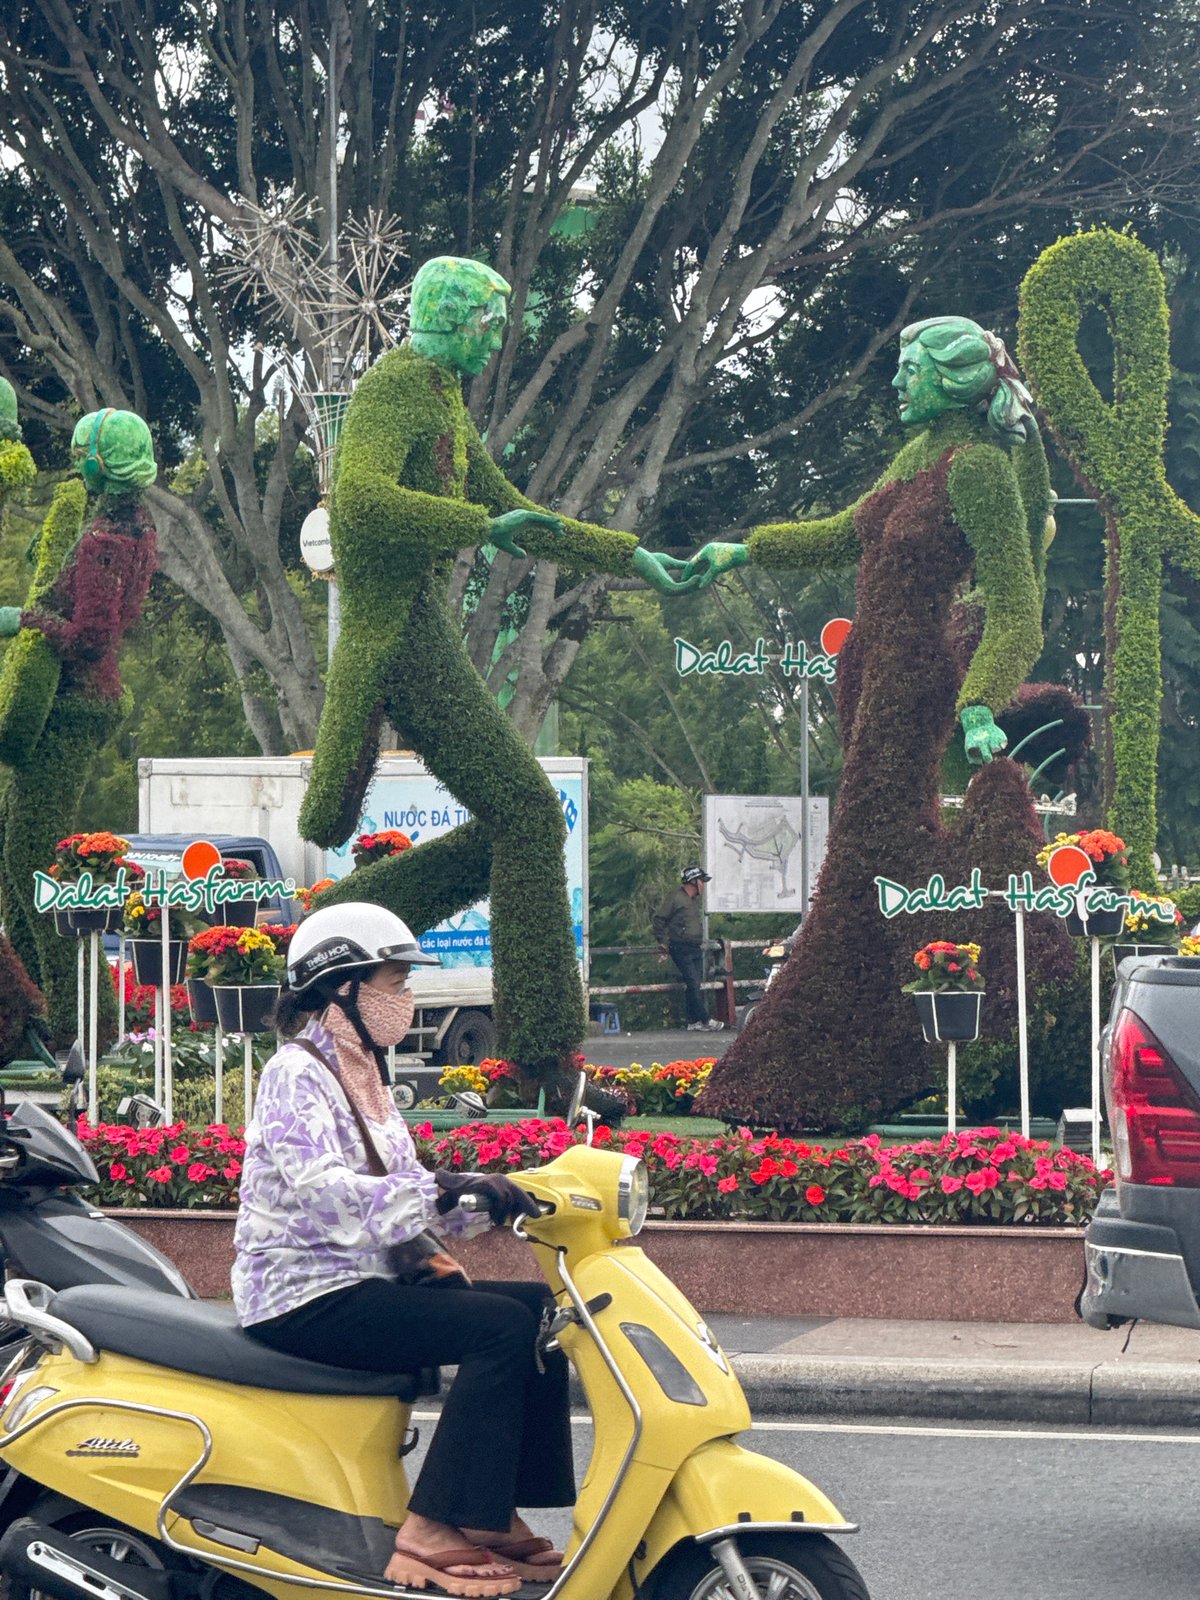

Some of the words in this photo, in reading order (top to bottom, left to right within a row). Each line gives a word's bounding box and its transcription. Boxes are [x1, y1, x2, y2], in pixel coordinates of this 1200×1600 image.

[674, 637, 769, 676] Dalat
[431, 806, 451, 826] ĐÁ
[33, 867, 131, 913] Dalat
[141, 865, 296, 913] Hasfarm
[875, 868, 988, 917] Dalat
[1005, 870, 1176, 922] Hasfarm
[421, 937, 436, 948] các
[437, 937, 451, 949] loại
[452, 936, 473, 947] nước
[474, 935, 484, 946] đá
